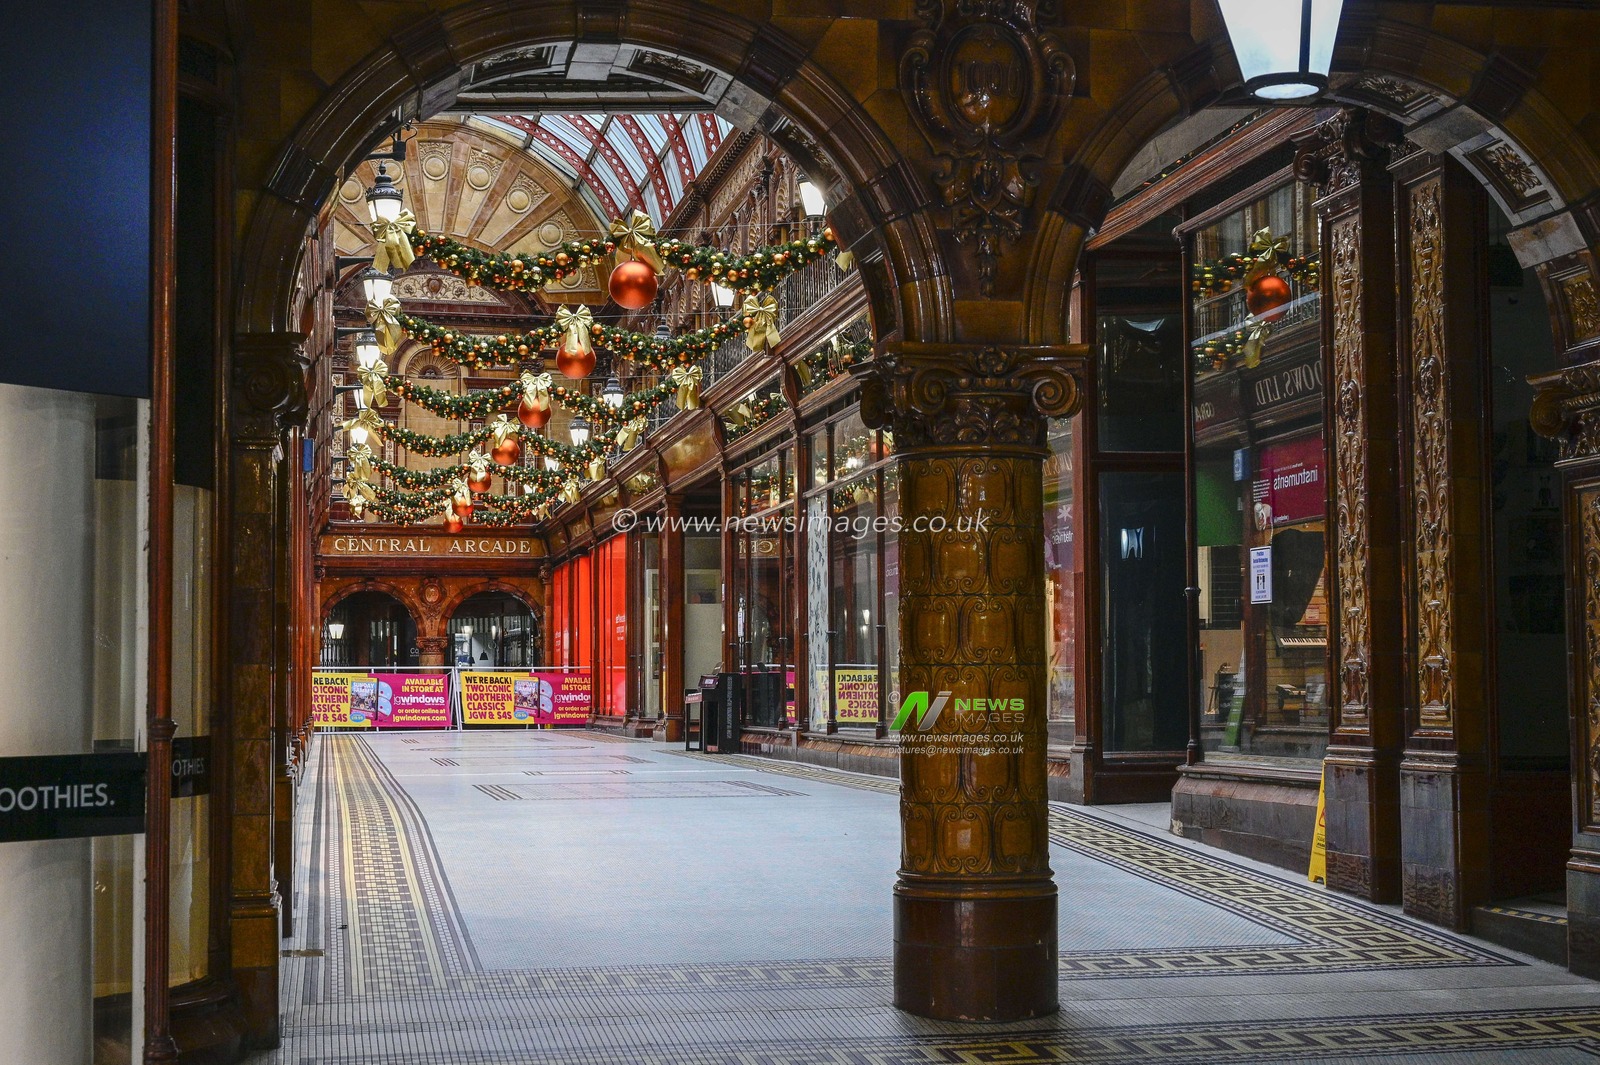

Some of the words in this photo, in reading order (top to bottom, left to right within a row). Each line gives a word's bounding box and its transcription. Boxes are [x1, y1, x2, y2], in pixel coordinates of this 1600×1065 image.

[335, 538, 430, 552] CENTRAL
[450, 540, 531, 554] ARCADE
[325, 677, 348, 686] BACK!
[320, 686, 348, 694] ICONIC
[486, 684, 511, 692] ICONIC
[312, 694, 348, 704] RTHERN
[394, 694, 444, 706] jgwindows
[466, 692, 512, 702] NORTHERN
[554, 692, 590, 704] jgwindo
[467, 702, 505, 710] CLASSICS
[393, 714, 446, 722] jgwindows.com
[469, 711, 486, 720] JGW
[488, 712, 494, 720] &
[496, 711, 512, 720] S4S
[0, 783, 115, 812] OOTHIES.
